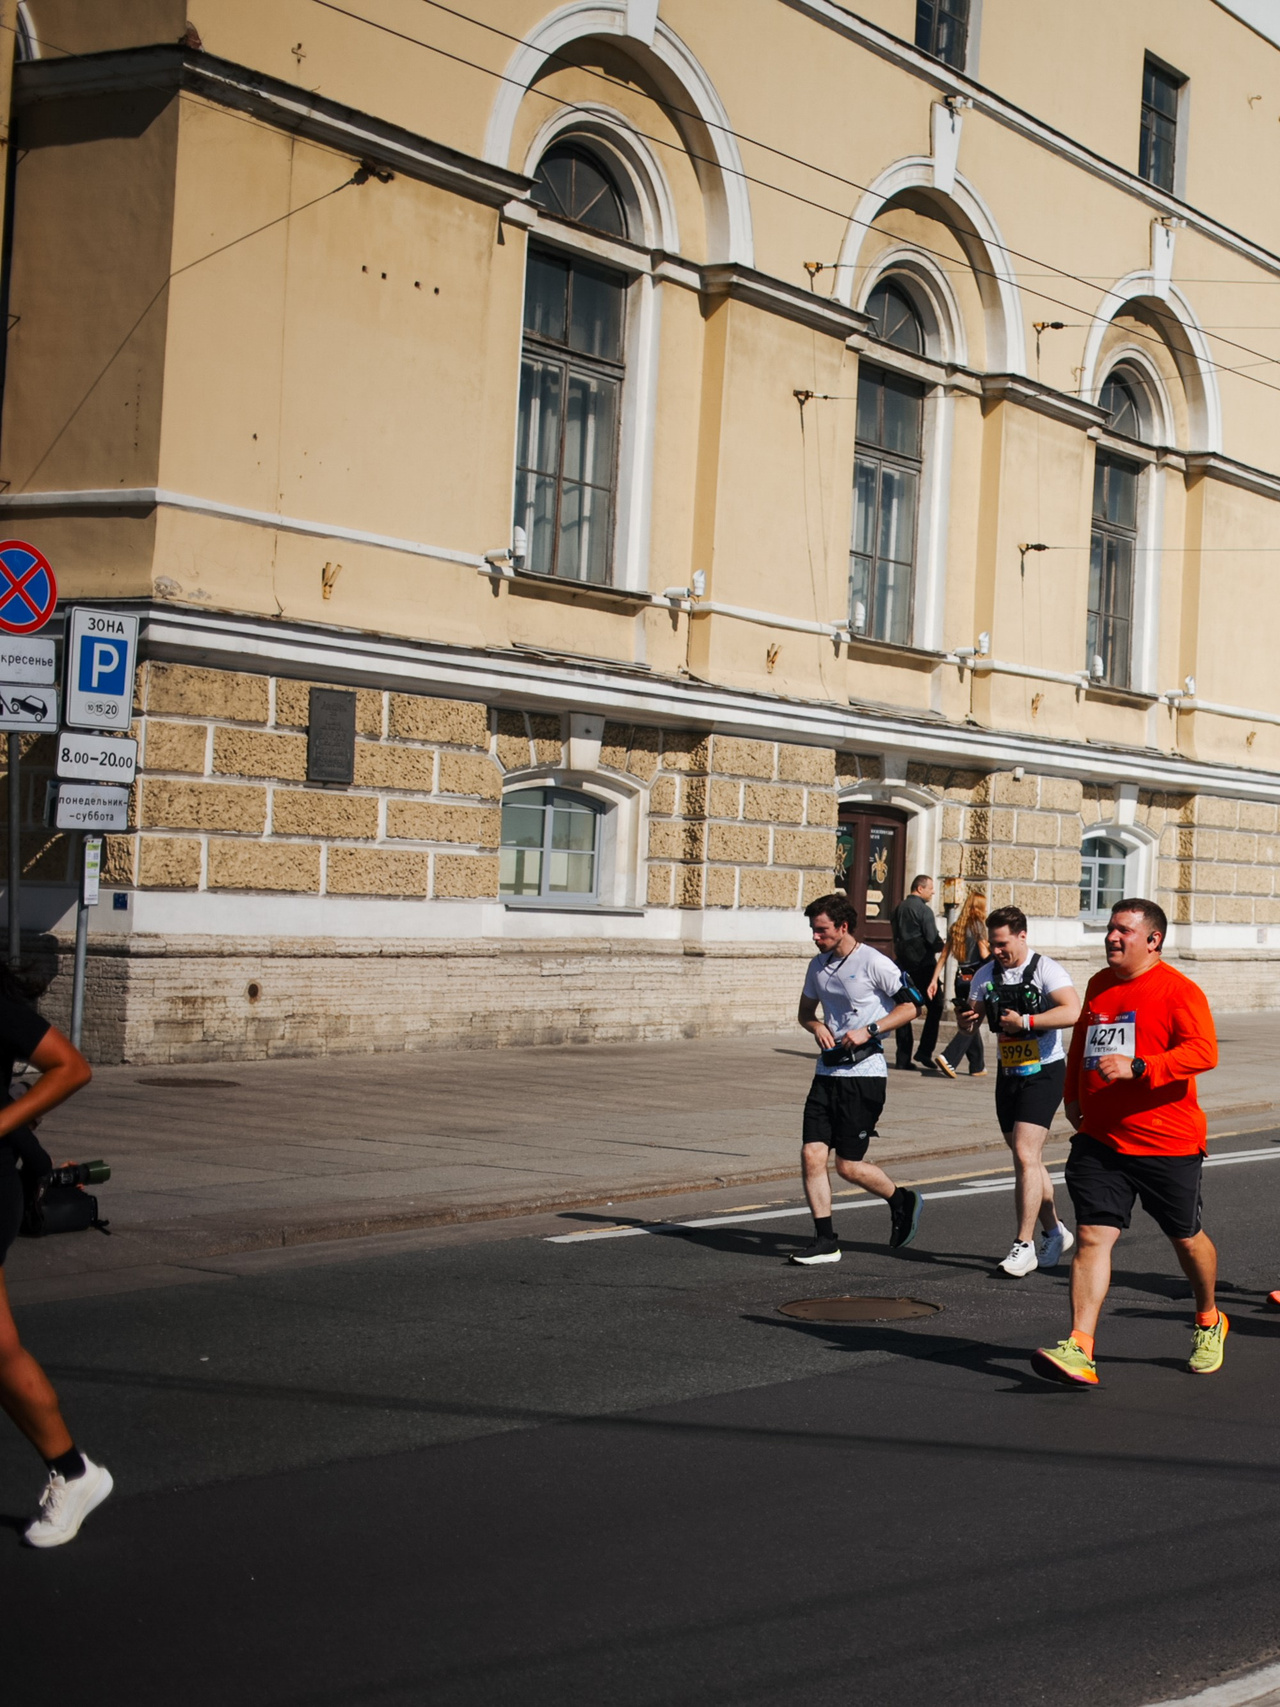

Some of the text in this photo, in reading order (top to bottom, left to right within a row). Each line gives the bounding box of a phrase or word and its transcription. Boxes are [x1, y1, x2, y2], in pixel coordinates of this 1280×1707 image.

[88, 617, 125, 634] ЗОНА
[1, 654, 54, 667] кресенье
[91, 642, 120, 688] P
[95, 704, 103, 713] 15
[105, 704, 117, 715] 20
[1090, 1027, 1125, 1046] 4271
[1001, 1043, 1033, 1060] 5996
